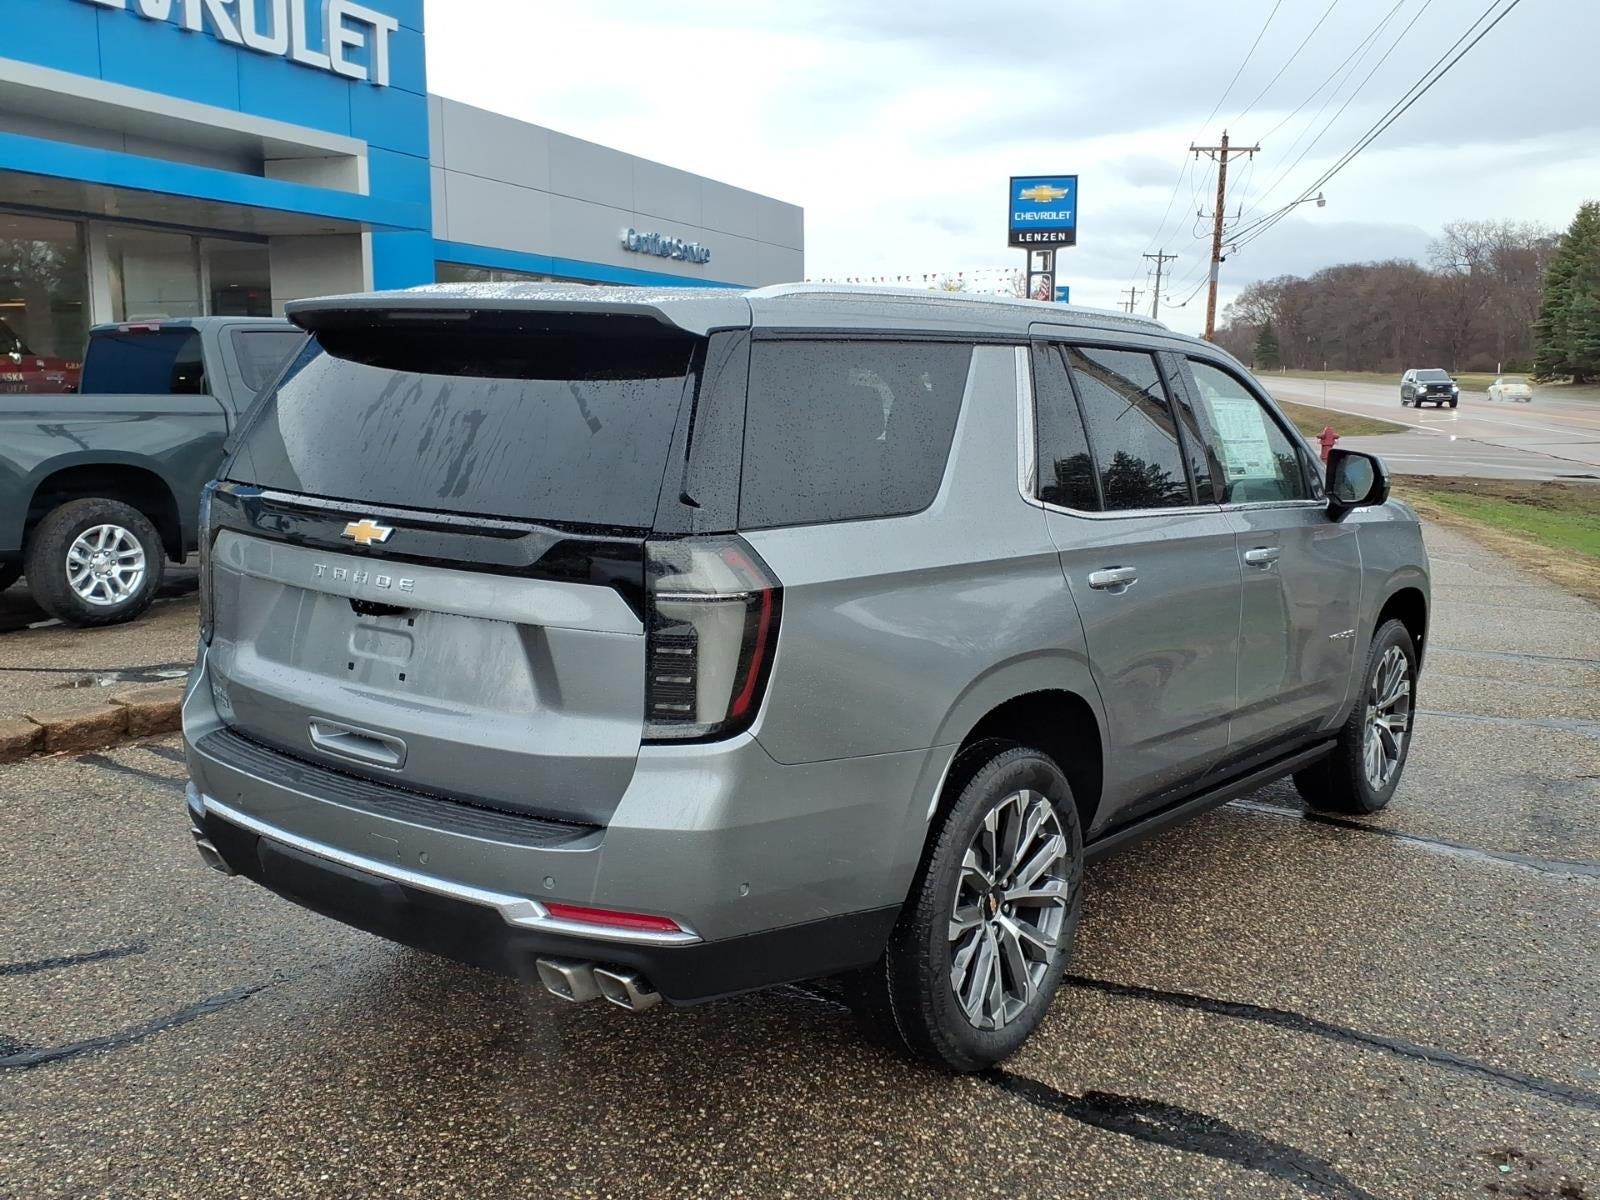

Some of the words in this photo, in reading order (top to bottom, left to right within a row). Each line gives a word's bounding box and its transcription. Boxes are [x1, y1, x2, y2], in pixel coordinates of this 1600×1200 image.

[1014, 211, 1071, 221] CHEVROLET
[1018, 233, 1066, 241] LENZEN
[671, 238, 710, 263] Service
[313, 562, 416, 593] TAHOE
